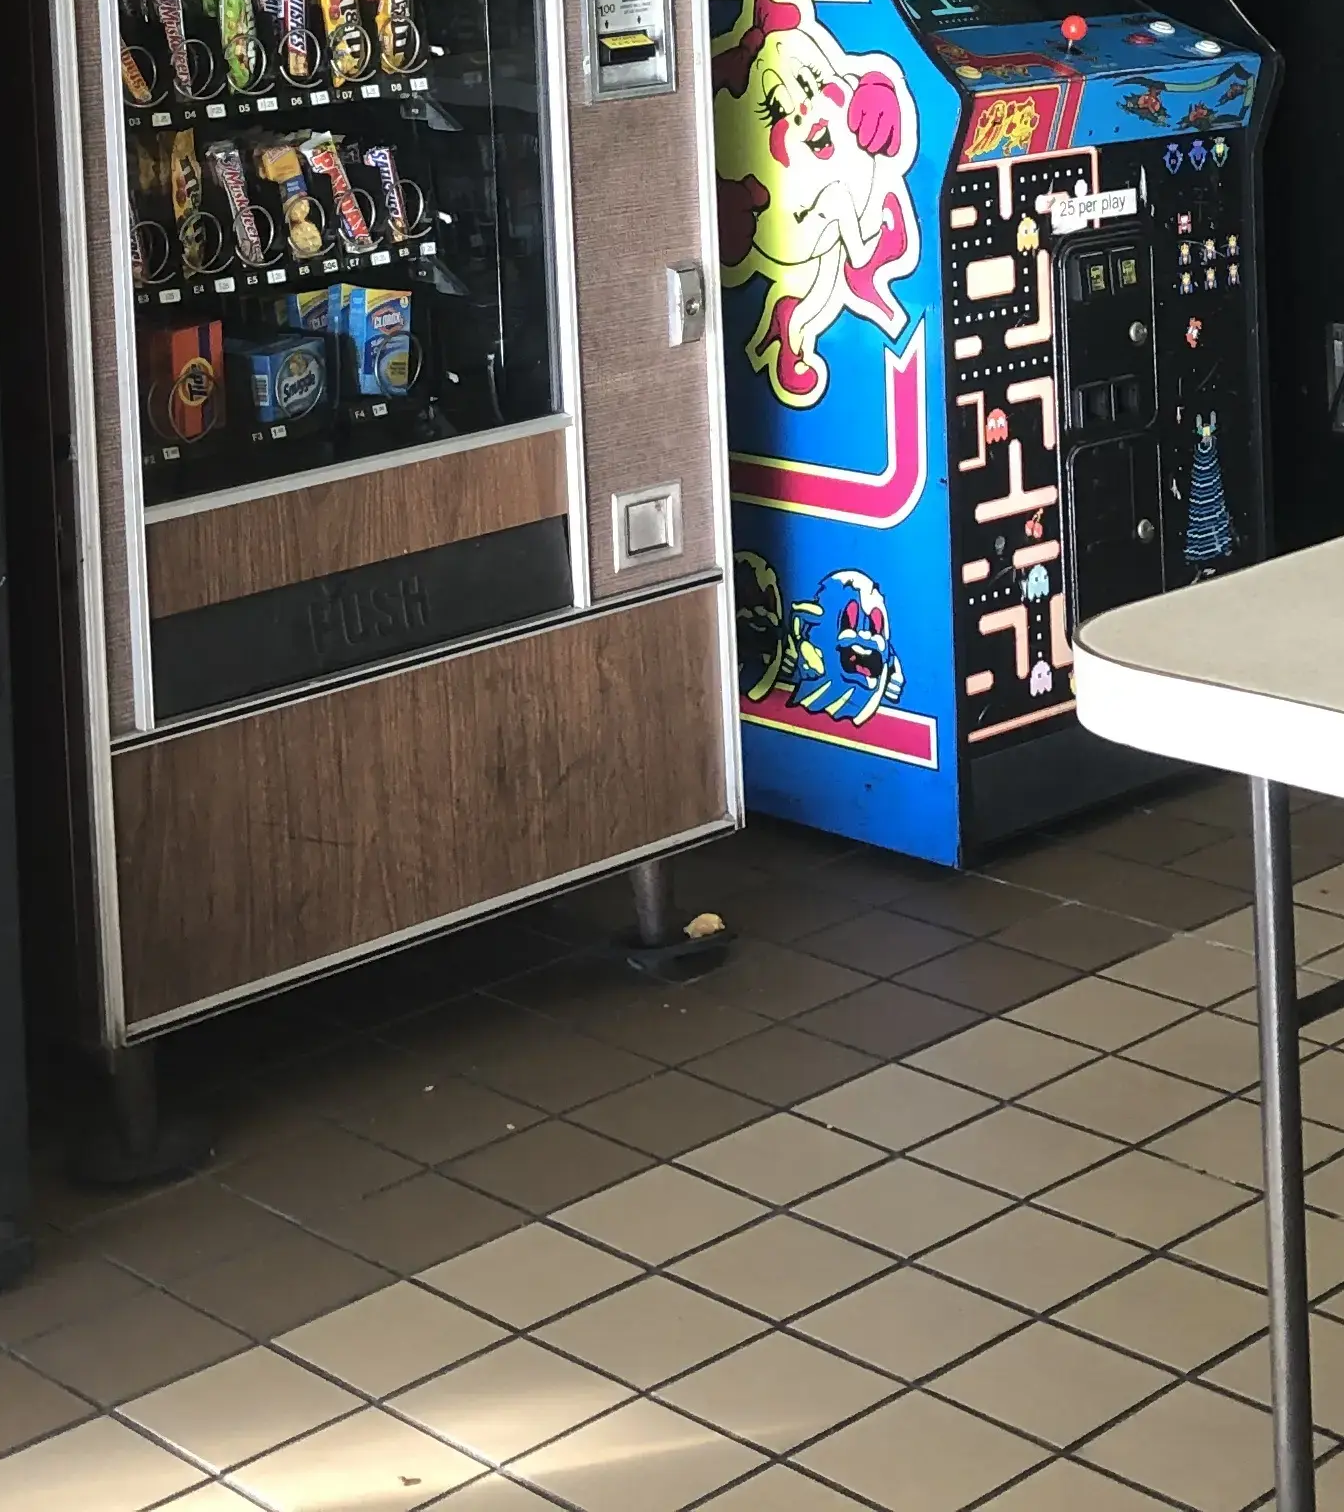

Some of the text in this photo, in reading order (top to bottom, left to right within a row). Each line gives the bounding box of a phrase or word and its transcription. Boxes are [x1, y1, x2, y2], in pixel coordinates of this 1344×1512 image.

[342, 90, 353, 99] D7
[291, 96, 303, 106] D6
[239, 103, 251, 113] D5
[185, 110, 197, 119] D4
[1060, 193, 1126, 218] 25 per play
[349, 258, 359, 267] E7
[247, 276, 258, 285] E5
[194, 285, 205, 294] E4
[306, 573, 433, 657] PUSH
